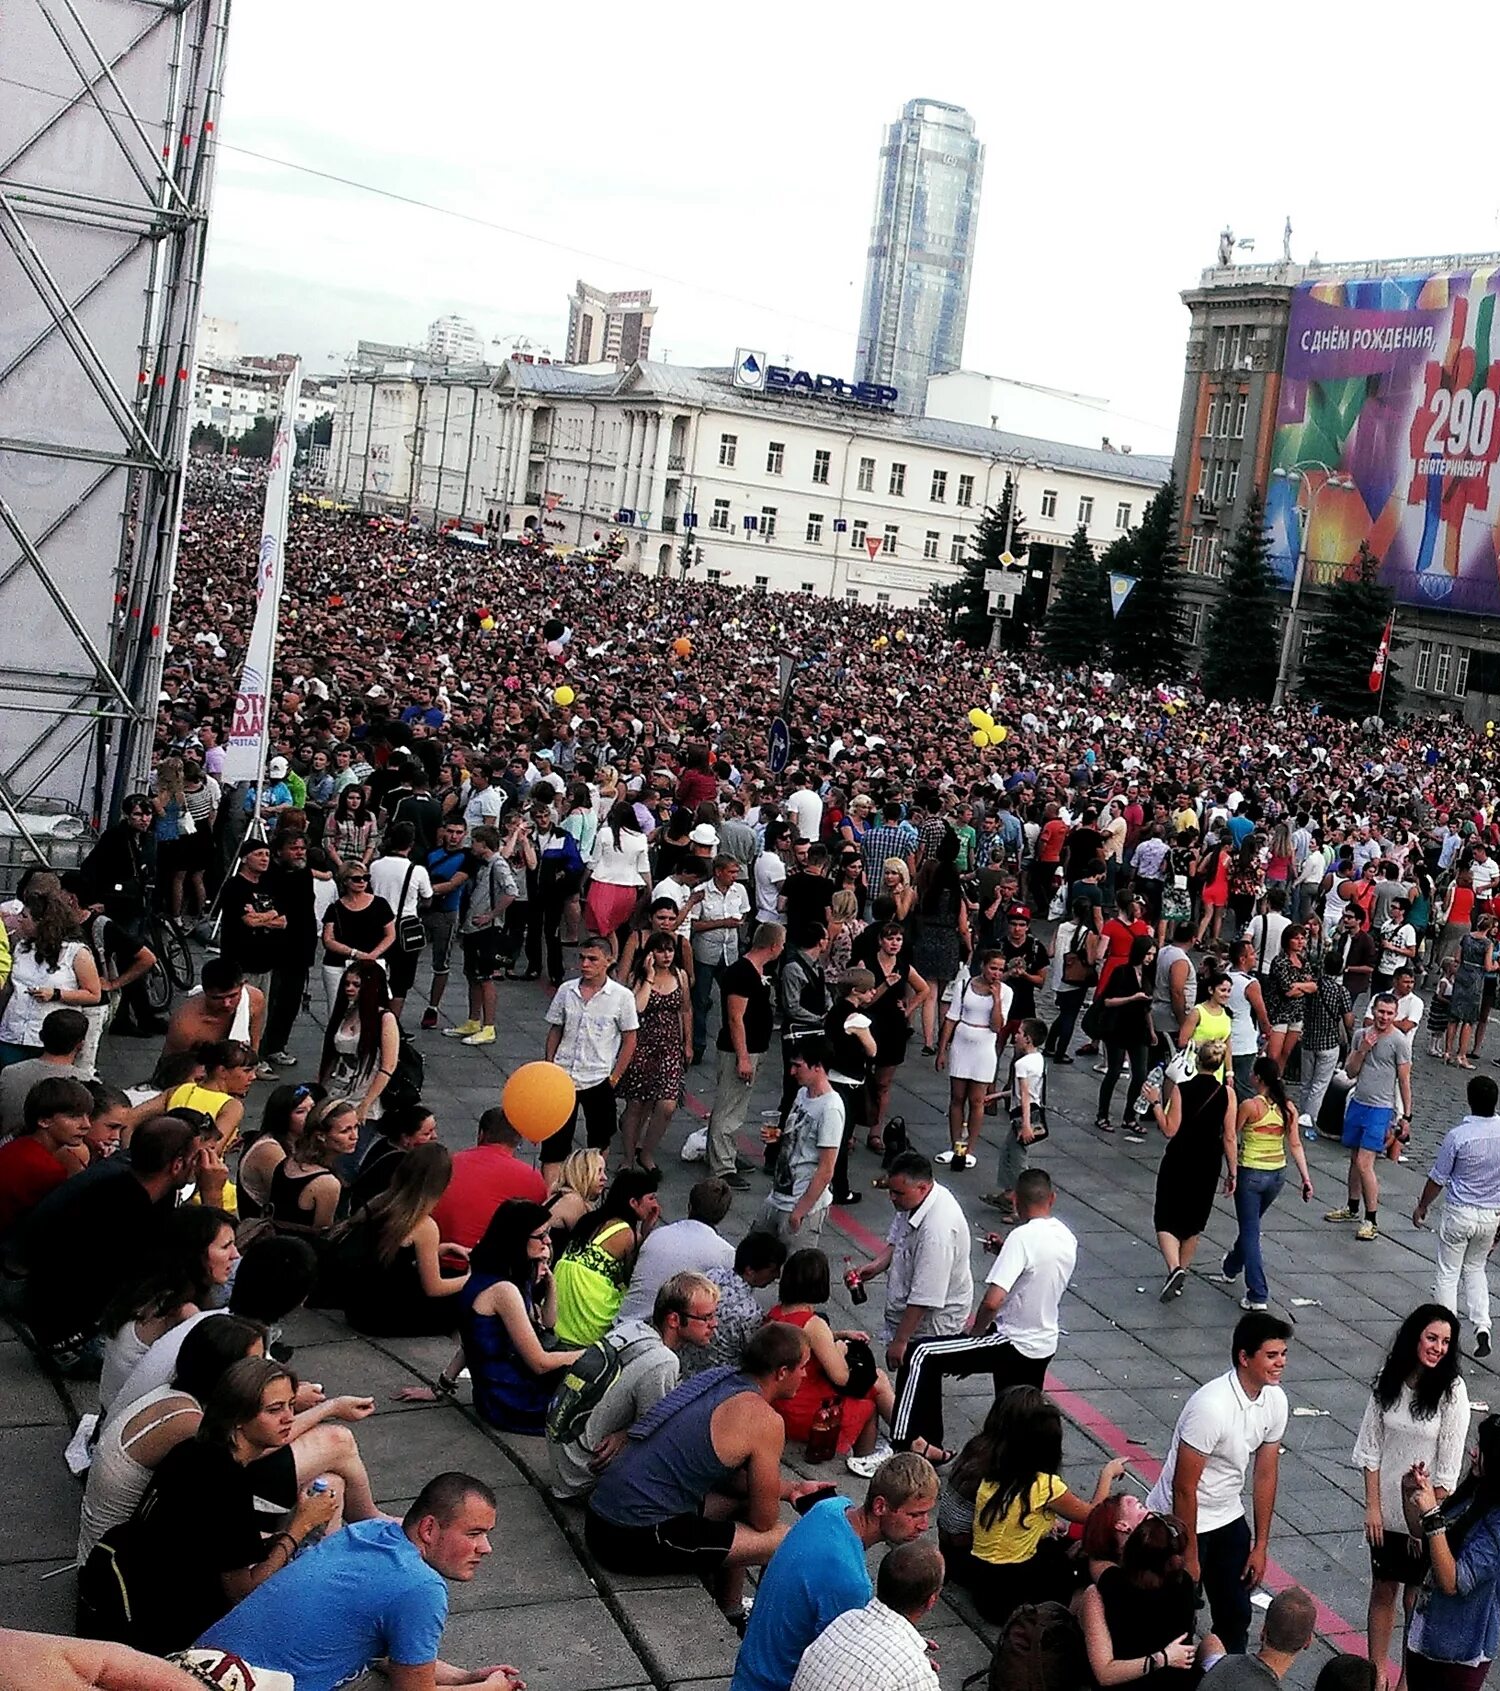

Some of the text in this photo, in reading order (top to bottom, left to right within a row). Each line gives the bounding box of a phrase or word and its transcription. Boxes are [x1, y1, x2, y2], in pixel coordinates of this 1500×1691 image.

[1300, 325, 1437, 353] С ДНЁМ РОЖДЕНИЯ,
[767, 365, 899, 405] БАРЬЕР
[1423, 388, 1496, 456] 290
[1417, 459, 1487, 477] ЕКАТЕРИНБУРГ
